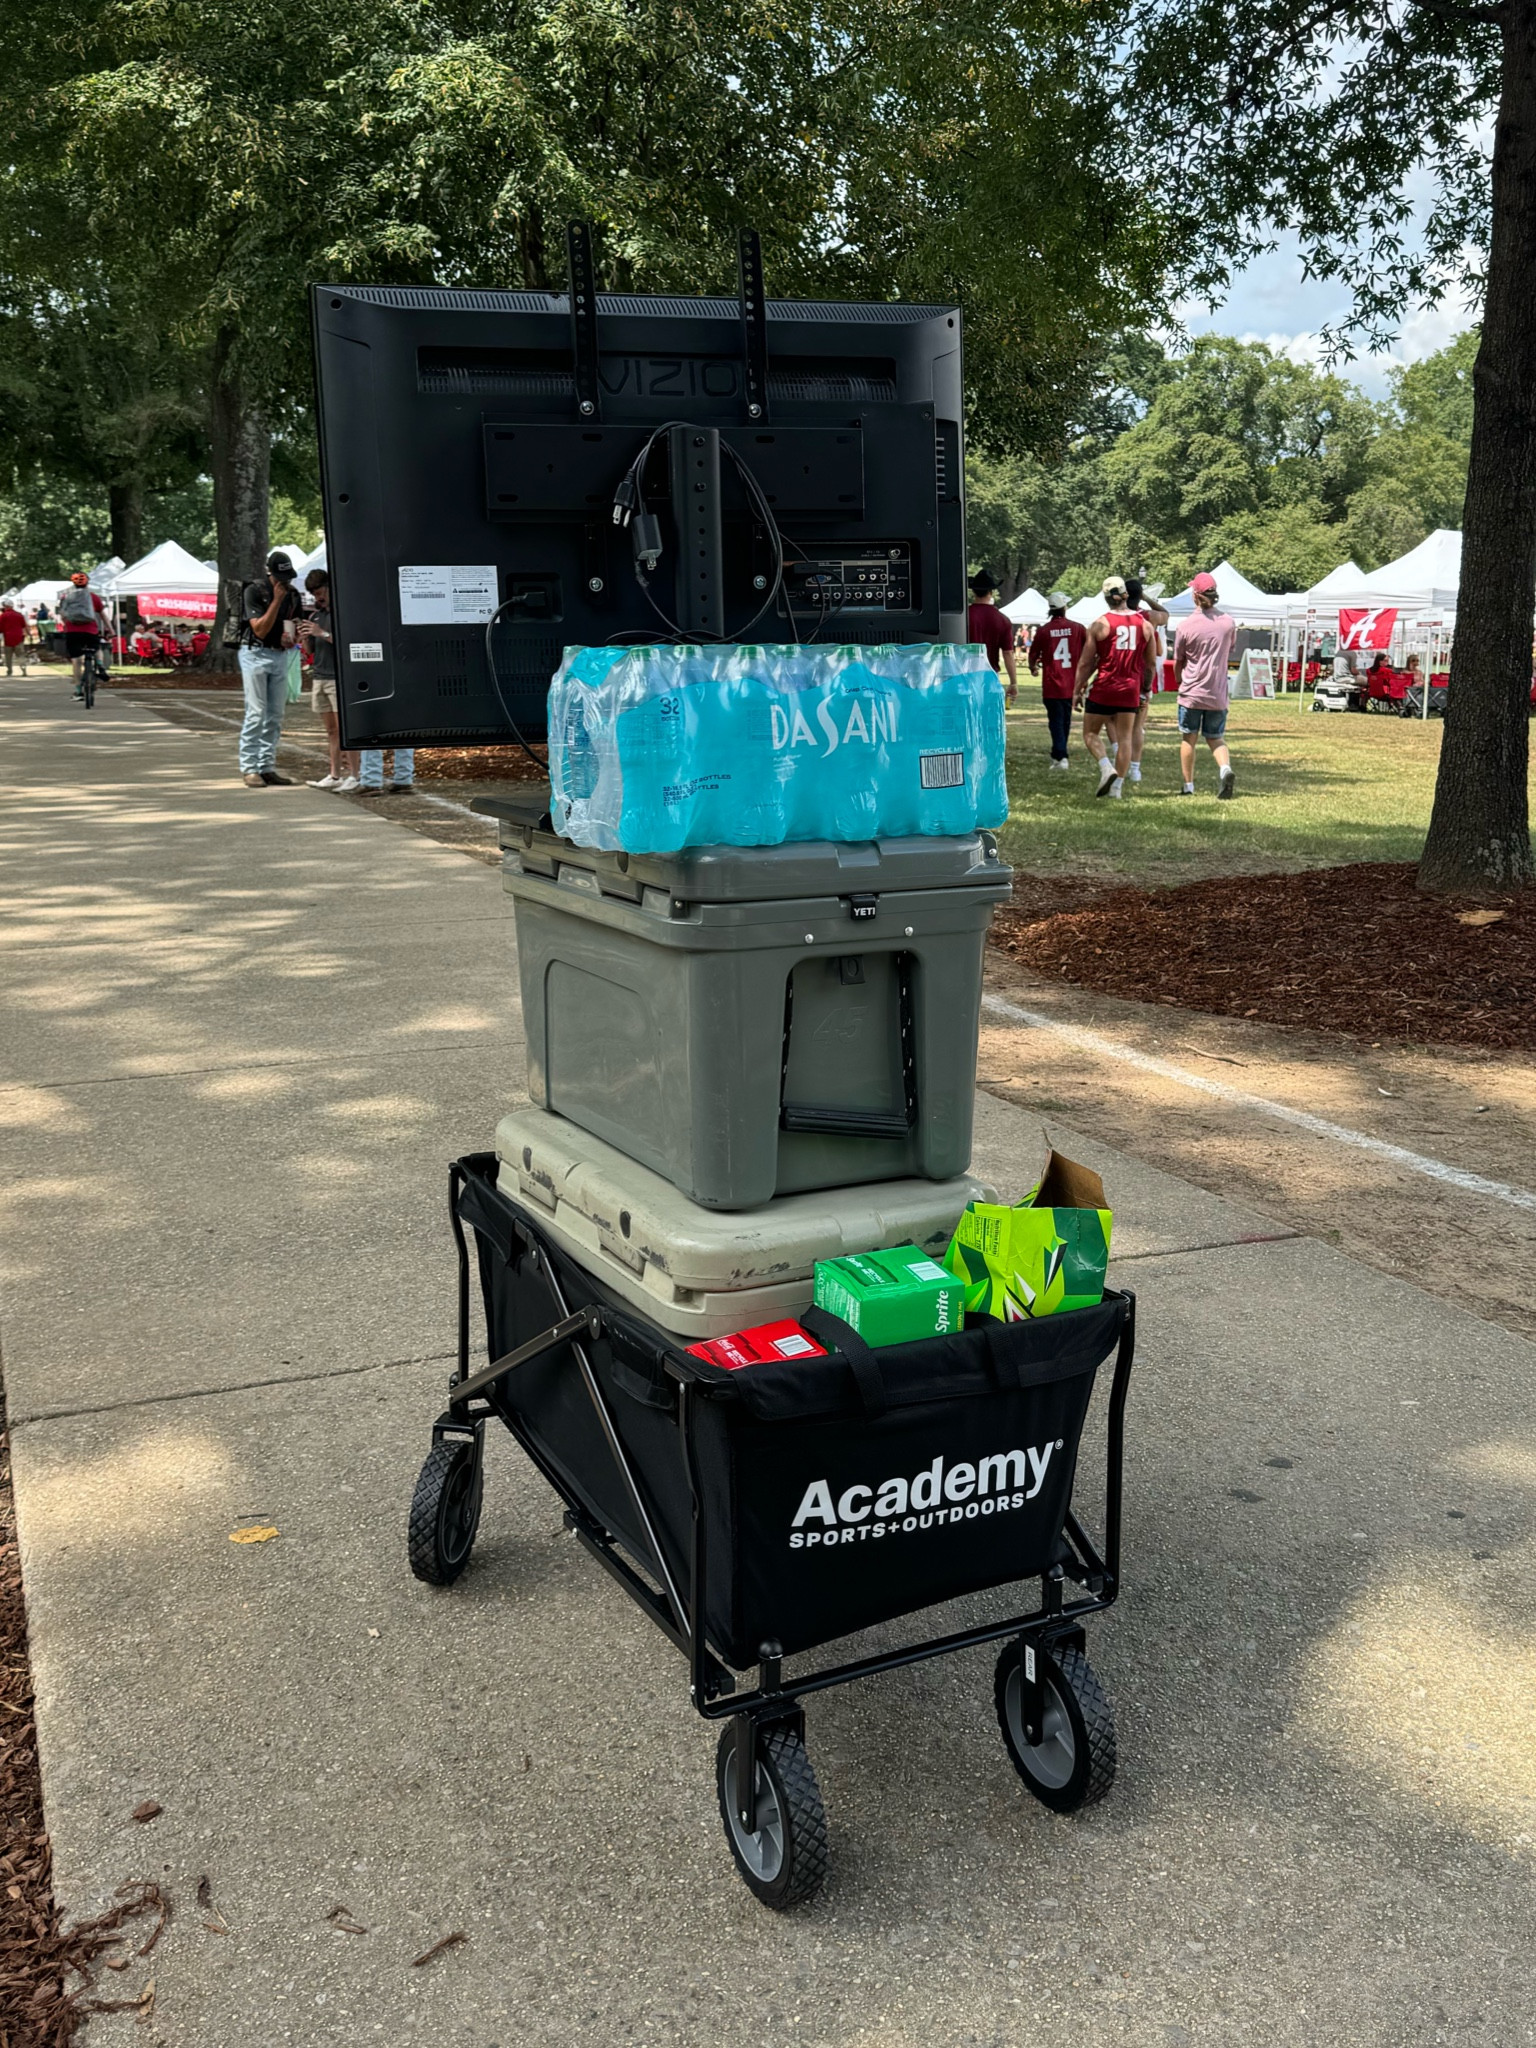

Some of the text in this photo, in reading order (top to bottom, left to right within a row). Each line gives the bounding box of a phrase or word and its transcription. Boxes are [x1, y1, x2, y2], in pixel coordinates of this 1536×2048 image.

[597, 359, 738, 397] VIZIO
[1116, 625, 1137, 651] 21
[1053, 638, 1072, 669] 4
[660, 698, 680, 714] 32
[770, 692, 897, 758] DASANI
[920, 747, 952, 755] RECYCLE
[699, 774, 732, 782] BOTTLES
[854, 907, 876, 916] YETI
[935, 1290, 950, 1333] Sprite
[789, 1492, 1025, 1549] SPORTS+OUTDOORS
